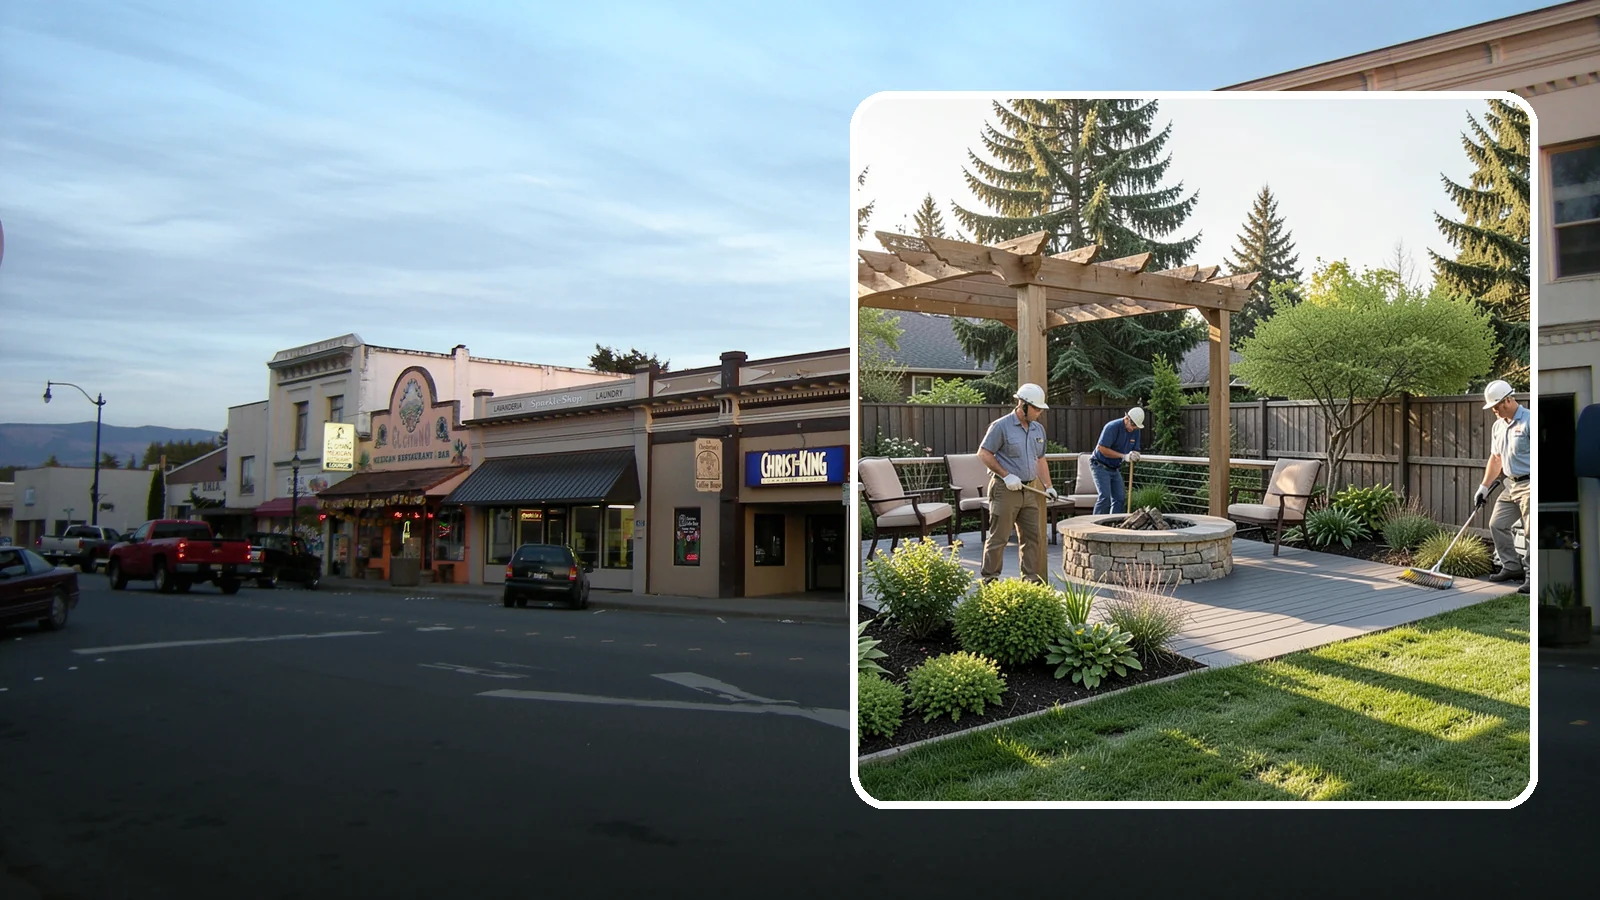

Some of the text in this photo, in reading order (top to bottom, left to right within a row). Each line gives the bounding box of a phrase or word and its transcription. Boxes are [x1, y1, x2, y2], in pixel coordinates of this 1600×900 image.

[530, 394, 582, 409] Sparkle Shop
[596, 389, 623, 400] LAUNDRY
[493, 402, 522, 412] LAVANDERIA
[374, 455, 396, 464] MEXICAN
[397, 451, 433, 462] RESTAURANT
[438, 450, 450, 459] BAR
[761, 450, 827, 478] CHRIST KING
